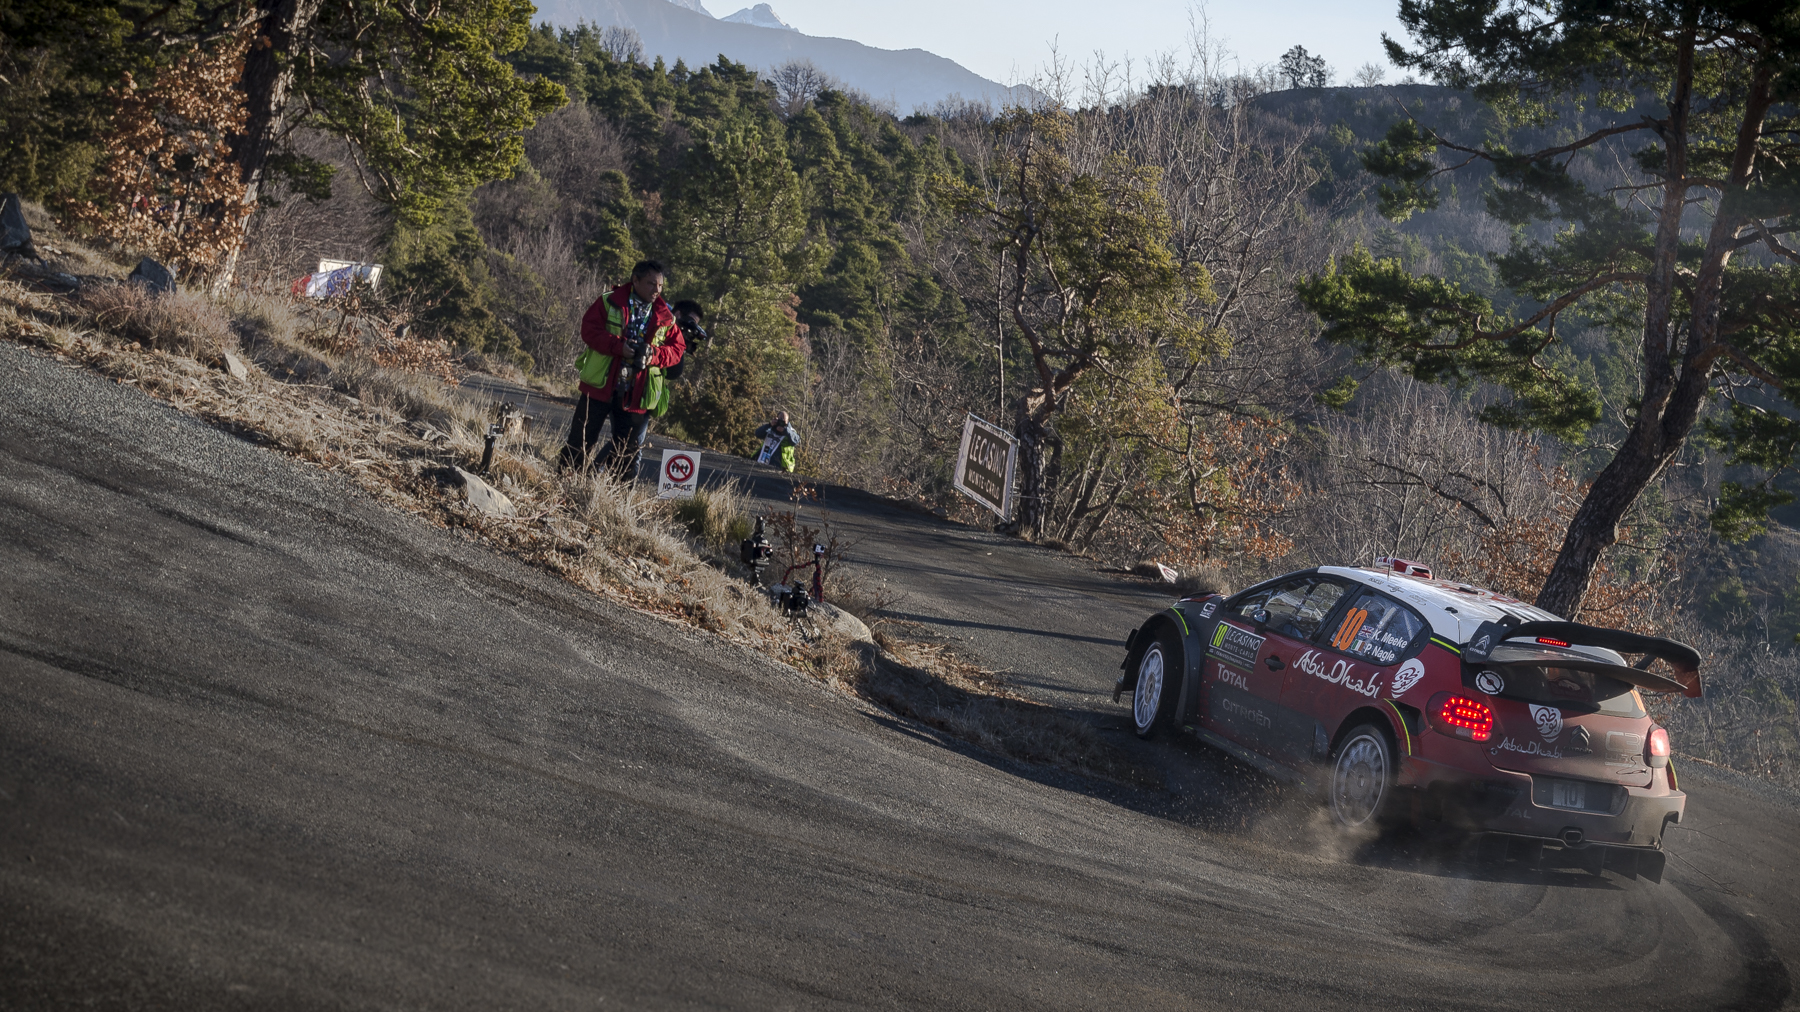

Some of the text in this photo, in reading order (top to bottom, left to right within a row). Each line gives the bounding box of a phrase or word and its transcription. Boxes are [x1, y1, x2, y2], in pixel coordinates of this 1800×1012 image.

[662, 482, 672, 490] NO
[1212, 624, 1229, 648] 10
[1332, 607, 1368, 651] 10
[1371, 629, 1408, 649] K. Meeke
[1363, 644, 1395, 662] P. Nagle
[1217, 663, 1249, 692] TOTAL
[1605, 731, 1642, 753] C3
[1561, 784, 1578, 806] 10
